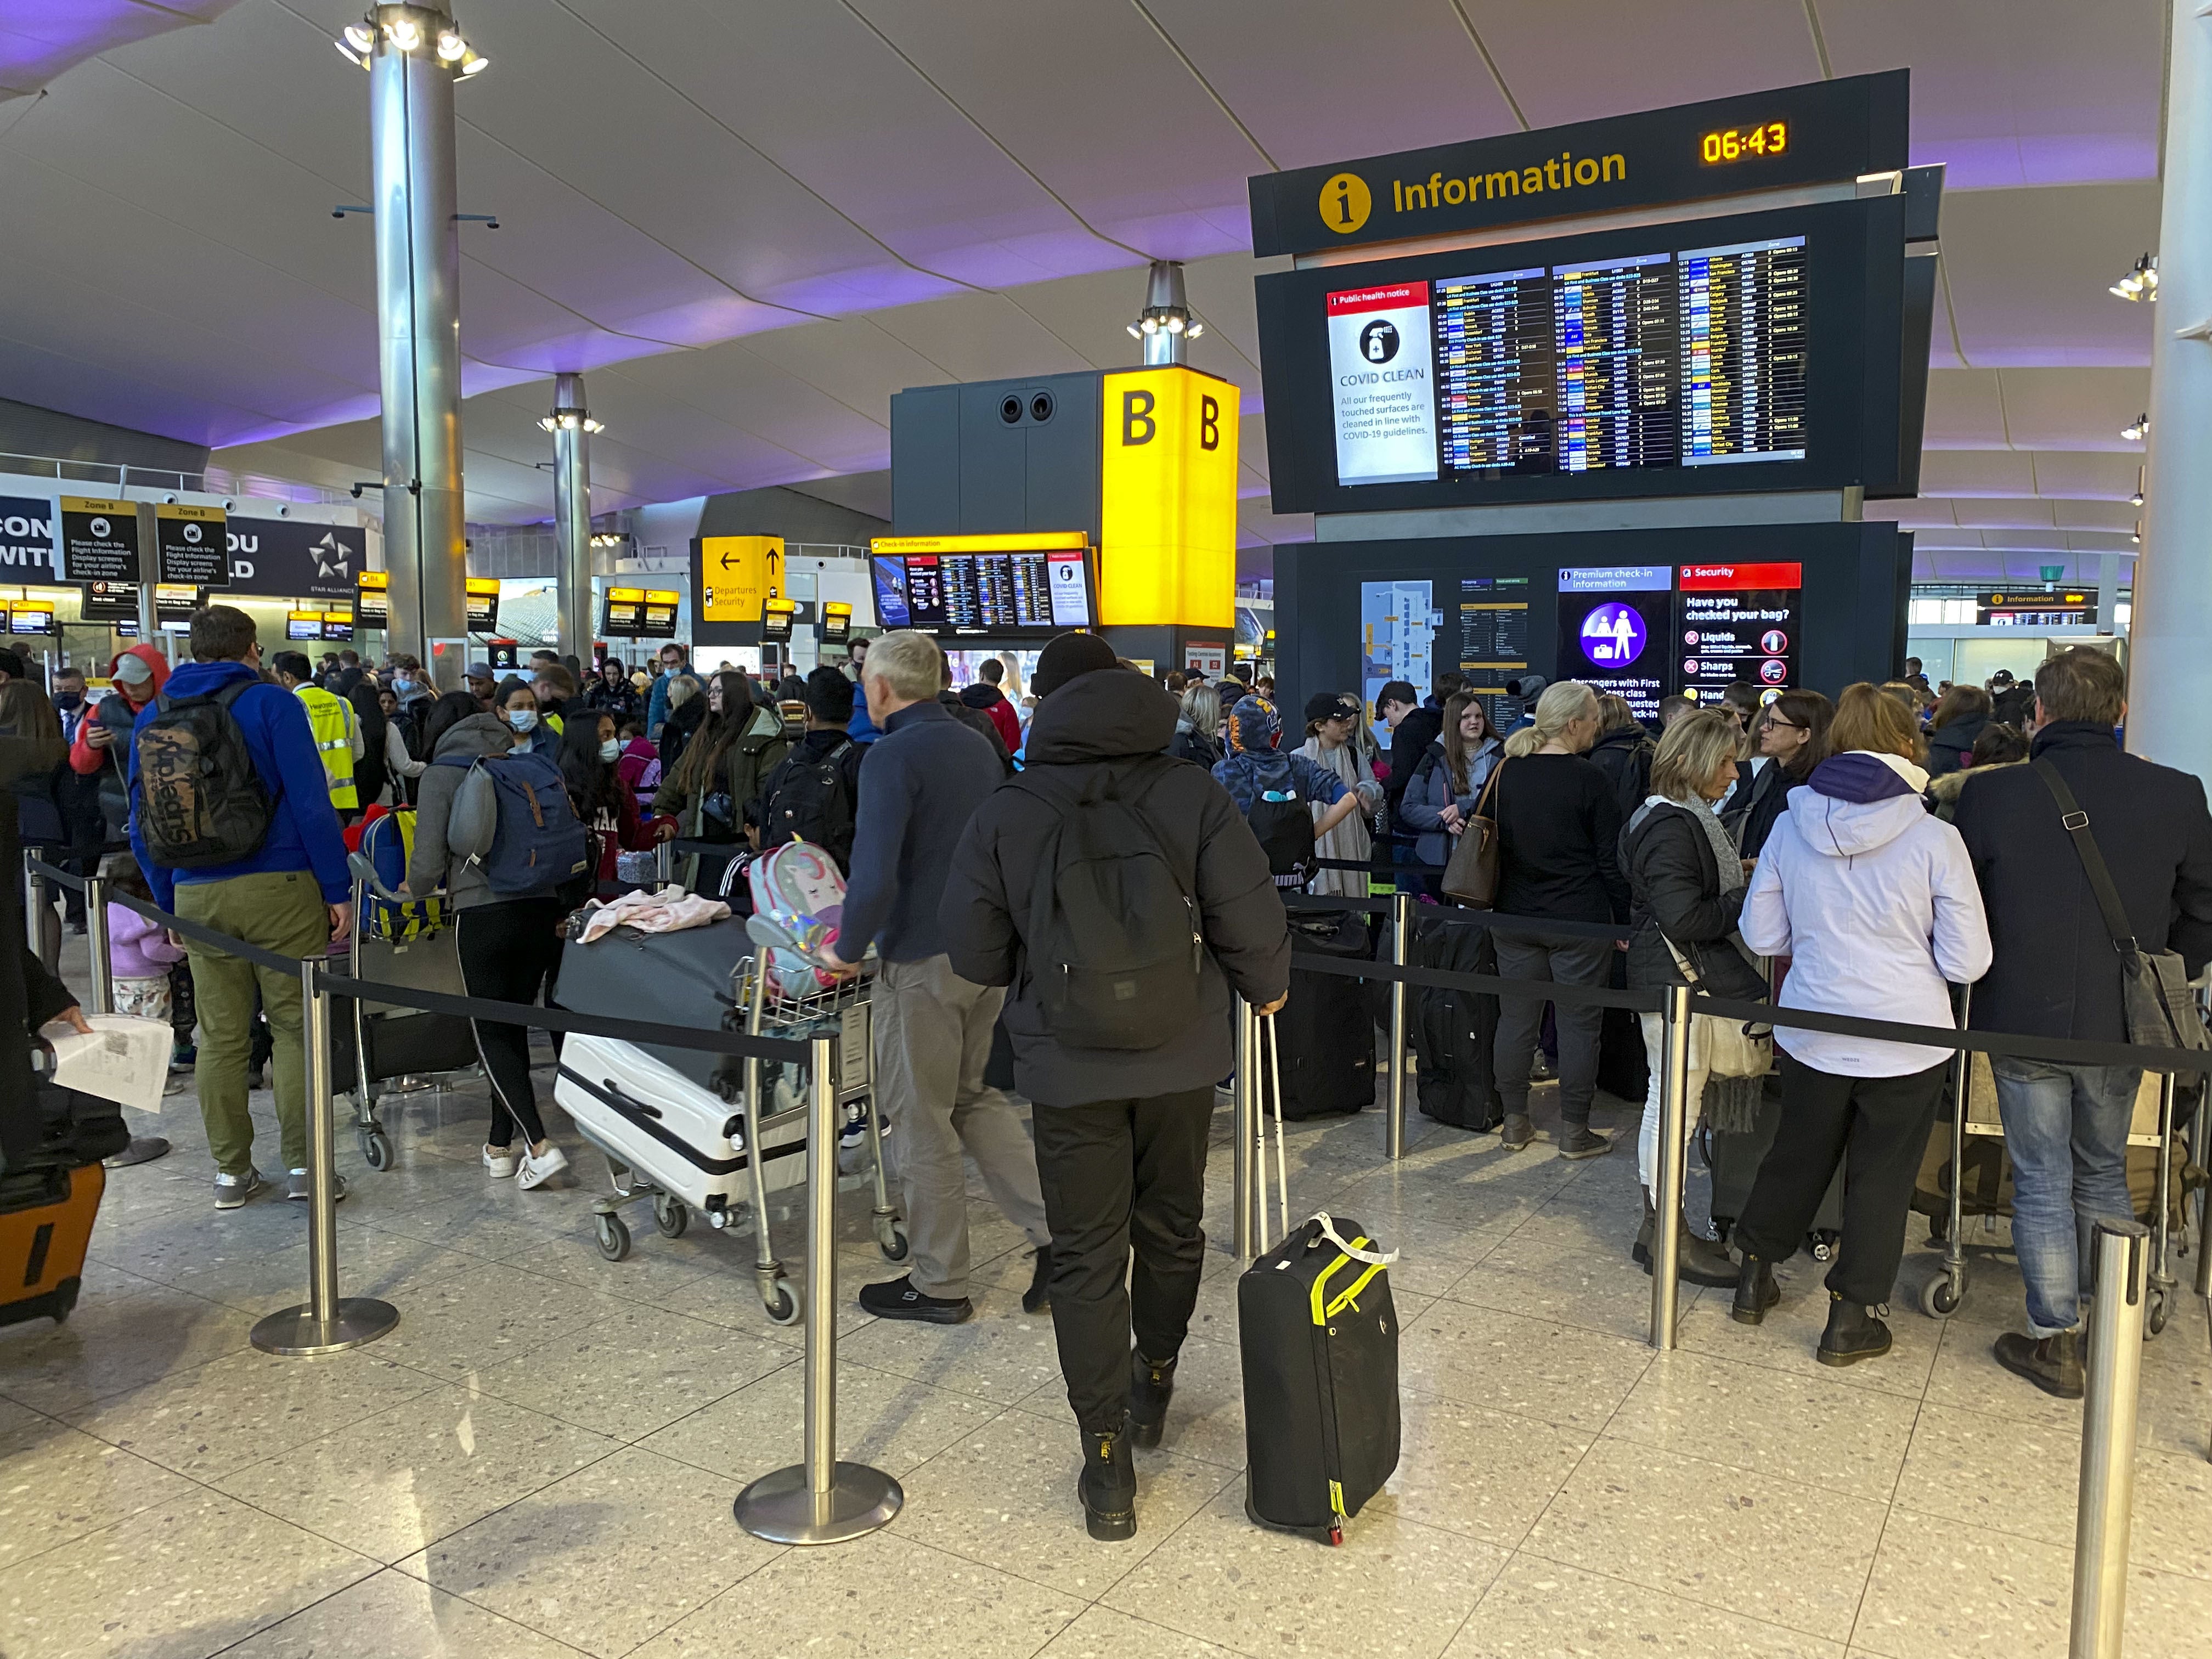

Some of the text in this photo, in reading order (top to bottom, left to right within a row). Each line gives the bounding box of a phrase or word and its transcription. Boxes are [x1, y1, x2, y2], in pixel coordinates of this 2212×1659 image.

[1703, 123, 1785, 162] 06:43
[1393, 154, 1626, 212] Information
[1340, 289, 1409, 304] Public health notice
[1341, 369, 1424, 386] COVID CLEAN
[1369, 392, 1412, 403] frequently
[1342, 407, 1374, 417] touched
[1376, 405, 1409, 414] surfaces
[1122, 390, 1155, 447] B
[1201, 394, 1219, 451] B
[1342, 419, 1373, 428] cleaned
[1375, 418, 1382, 426] in
[1401, 415, 1420, 424] with
[1344, 427, 1427, 440] COVID-19 guidelines.
[1573, 569, 1652, 579] Premium check-in
[1695, 568, 1734, 578] Security
[1573, 579, 1626, 588] information
[715, 586, 757, 596] Departures
[715, 597, 744, 607] Security
[1687, 598, 1738, 610] Have you
[1686, 609, 1789, 622] checked your bag?
[1701, 633, 1735, 643] Liquids
[1701, 662, 1733, 672] Sharps
[1618, 679, 1638, 687] with
[1640, 679, 1660, 687] First
[1626, 689, 1646, 697] class
[1701, 691, 1724, 699] Hand
